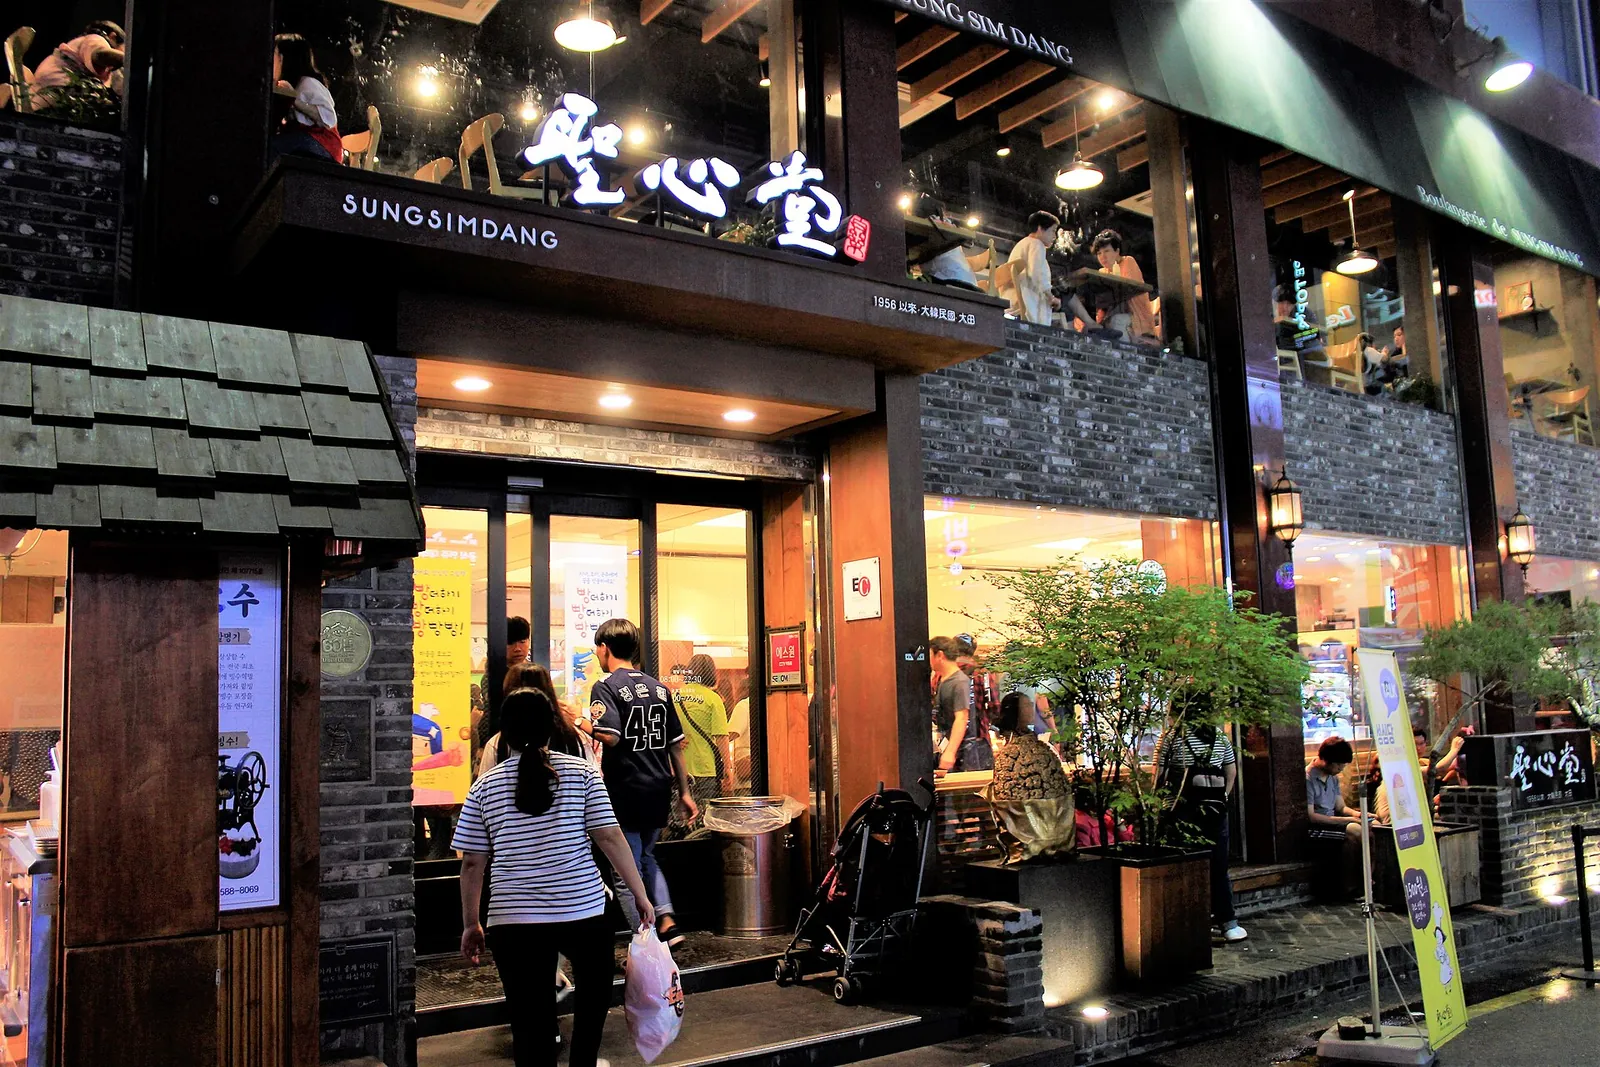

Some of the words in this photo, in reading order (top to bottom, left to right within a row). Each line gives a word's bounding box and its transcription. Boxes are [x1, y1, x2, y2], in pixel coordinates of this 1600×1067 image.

[903, 0, 964, 24] UNG
[967, 10, 1008, 41] SIM
[1009, 26, 1073, 64] DANG
[342, 193, 559, 249] SUNGSIMDANG
[1416, 184, 1488, 227] Boulangerie
[1491, 217, 1508, 237] de
[873, 295, 897, 310] 1956
[775, 644, 796, 660] 에스원
[625, 704, 668, 752] 43
